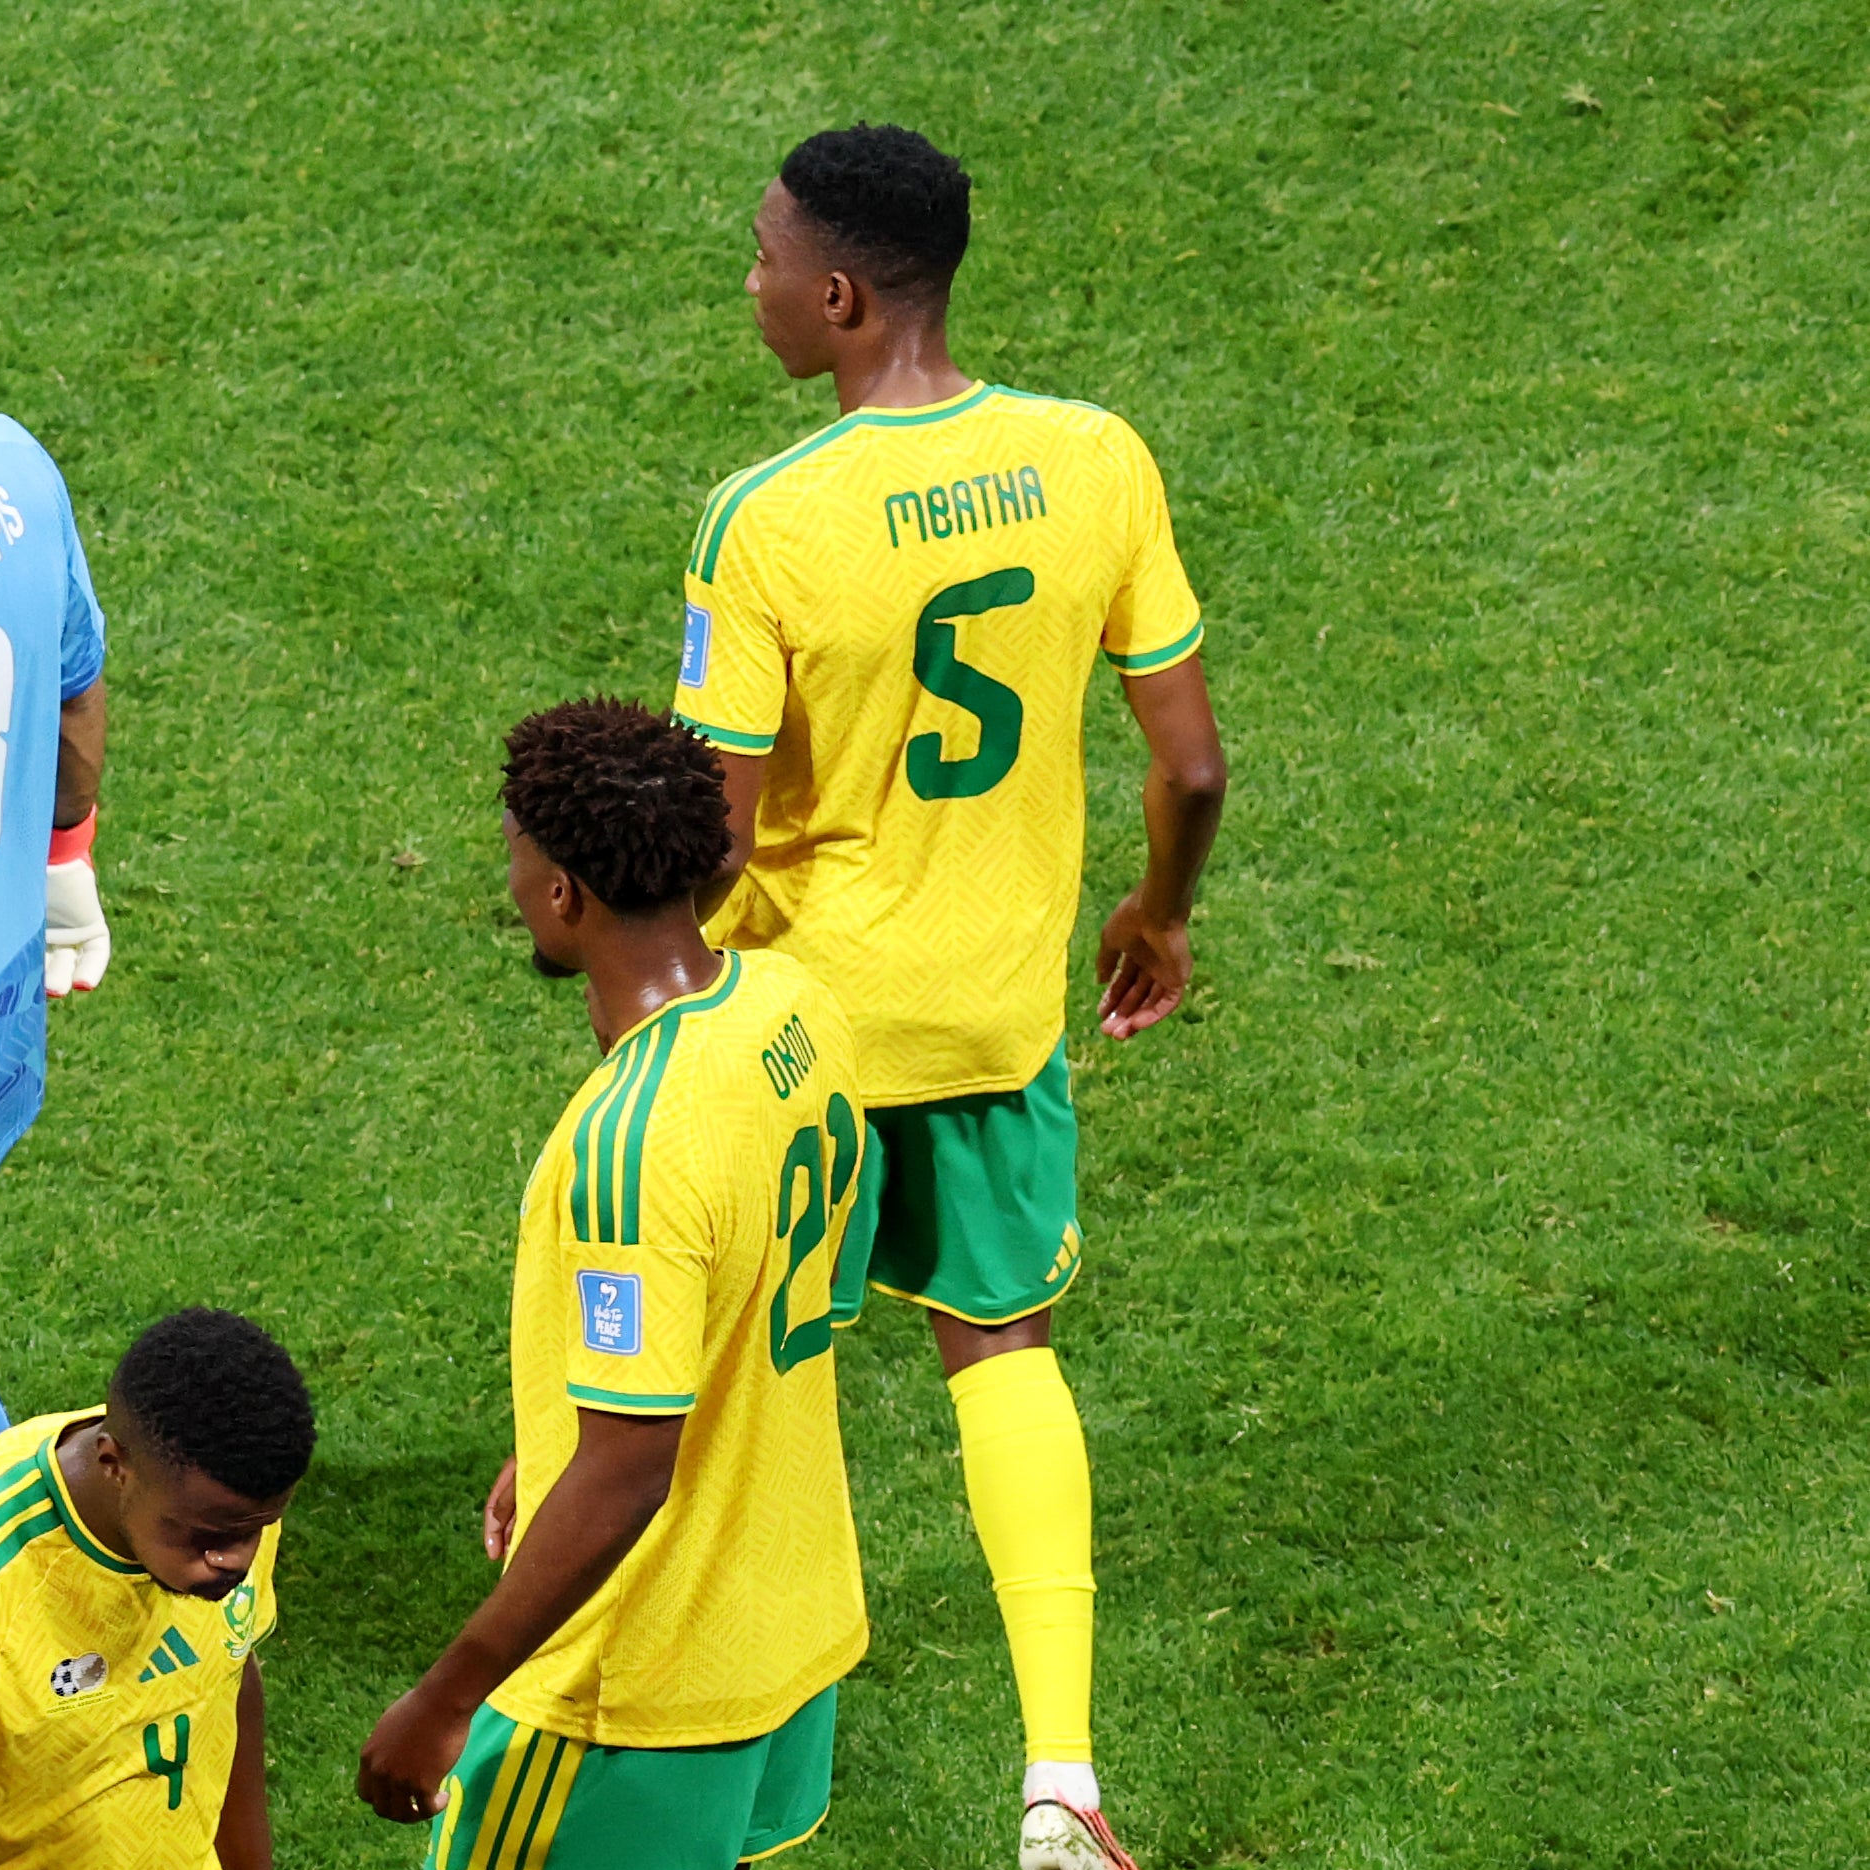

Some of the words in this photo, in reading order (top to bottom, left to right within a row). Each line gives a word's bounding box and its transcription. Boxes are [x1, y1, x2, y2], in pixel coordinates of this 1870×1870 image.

[885, 465, 1047, 549] MBATHA
[906, 566, 1036, 801] 5
[594, 1321, 623, 1339] PEACE
[142, 1713, 192, 1810] 4
